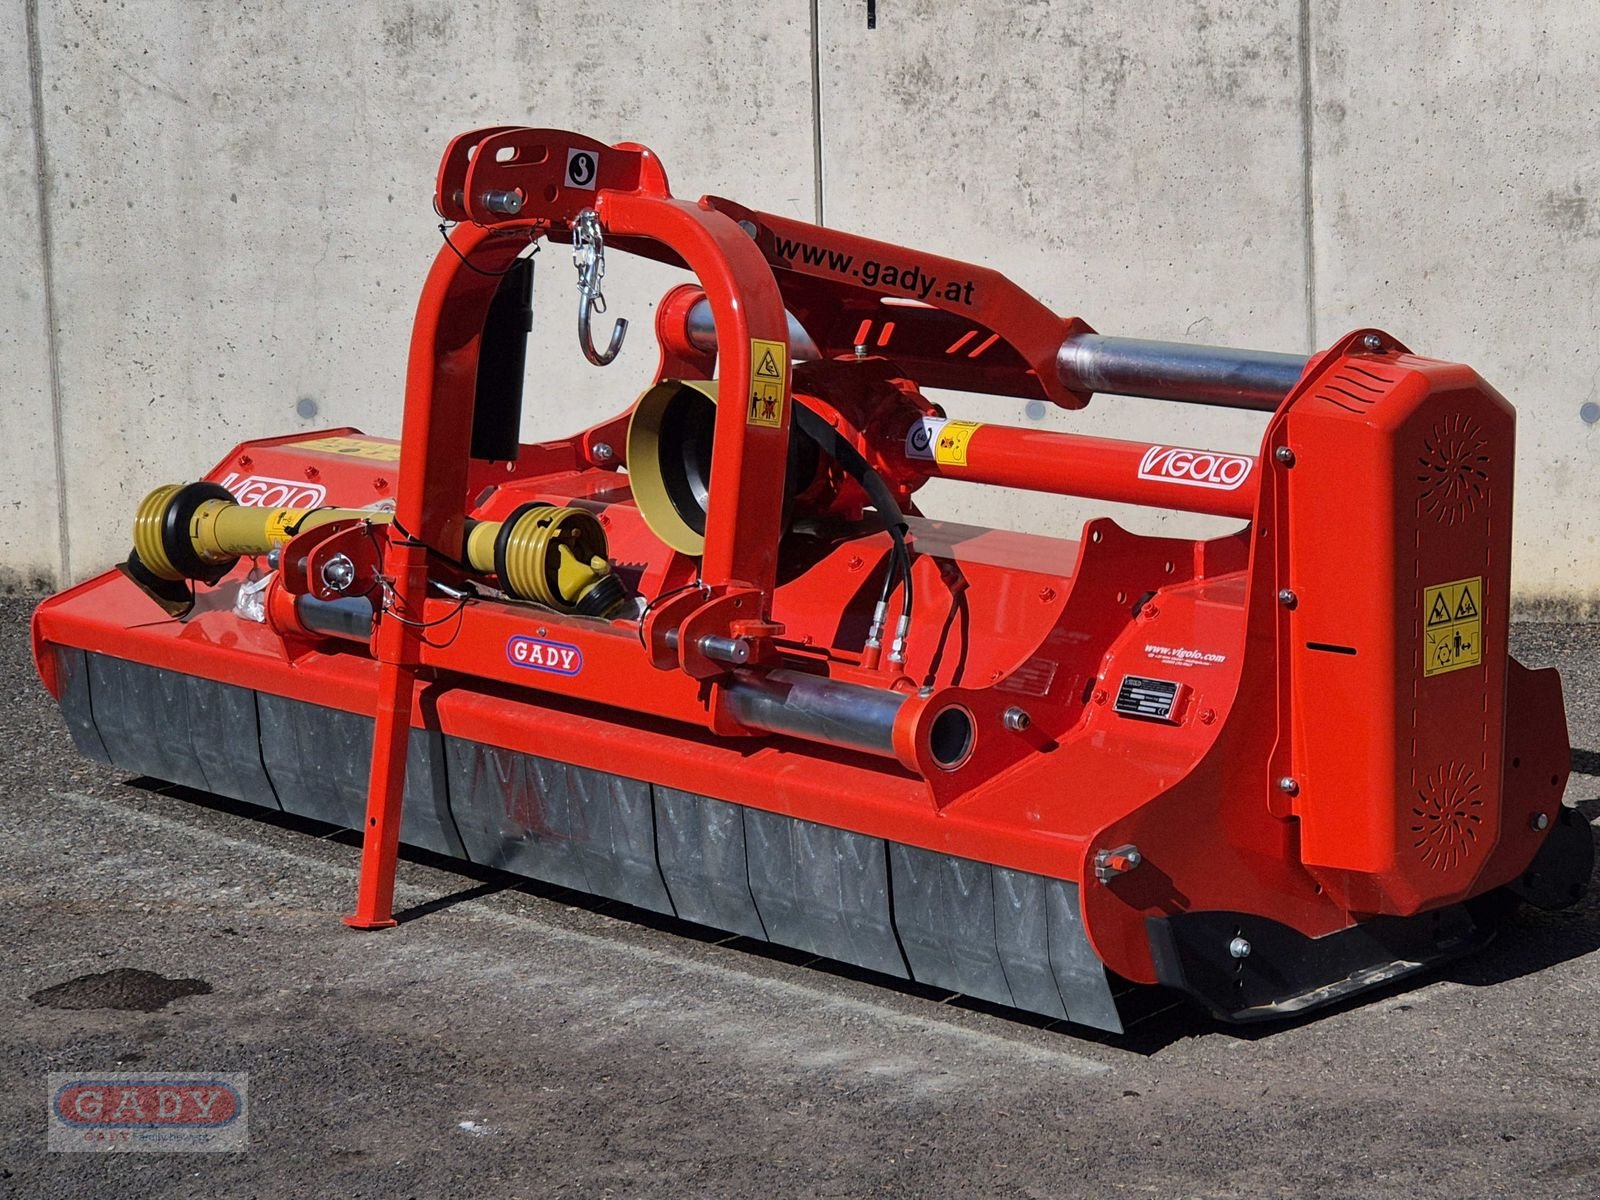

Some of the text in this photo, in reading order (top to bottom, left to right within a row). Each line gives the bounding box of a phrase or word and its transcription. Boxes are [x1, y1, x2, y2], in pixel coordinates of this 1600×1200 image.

[775, 236, 975, 305] www.gady.at
[1139, 446, 1252, 488] VIGOLO
[514, 641, 575, 669] GADY
[1144, 644, 1226, 663] www.vigolo.com
